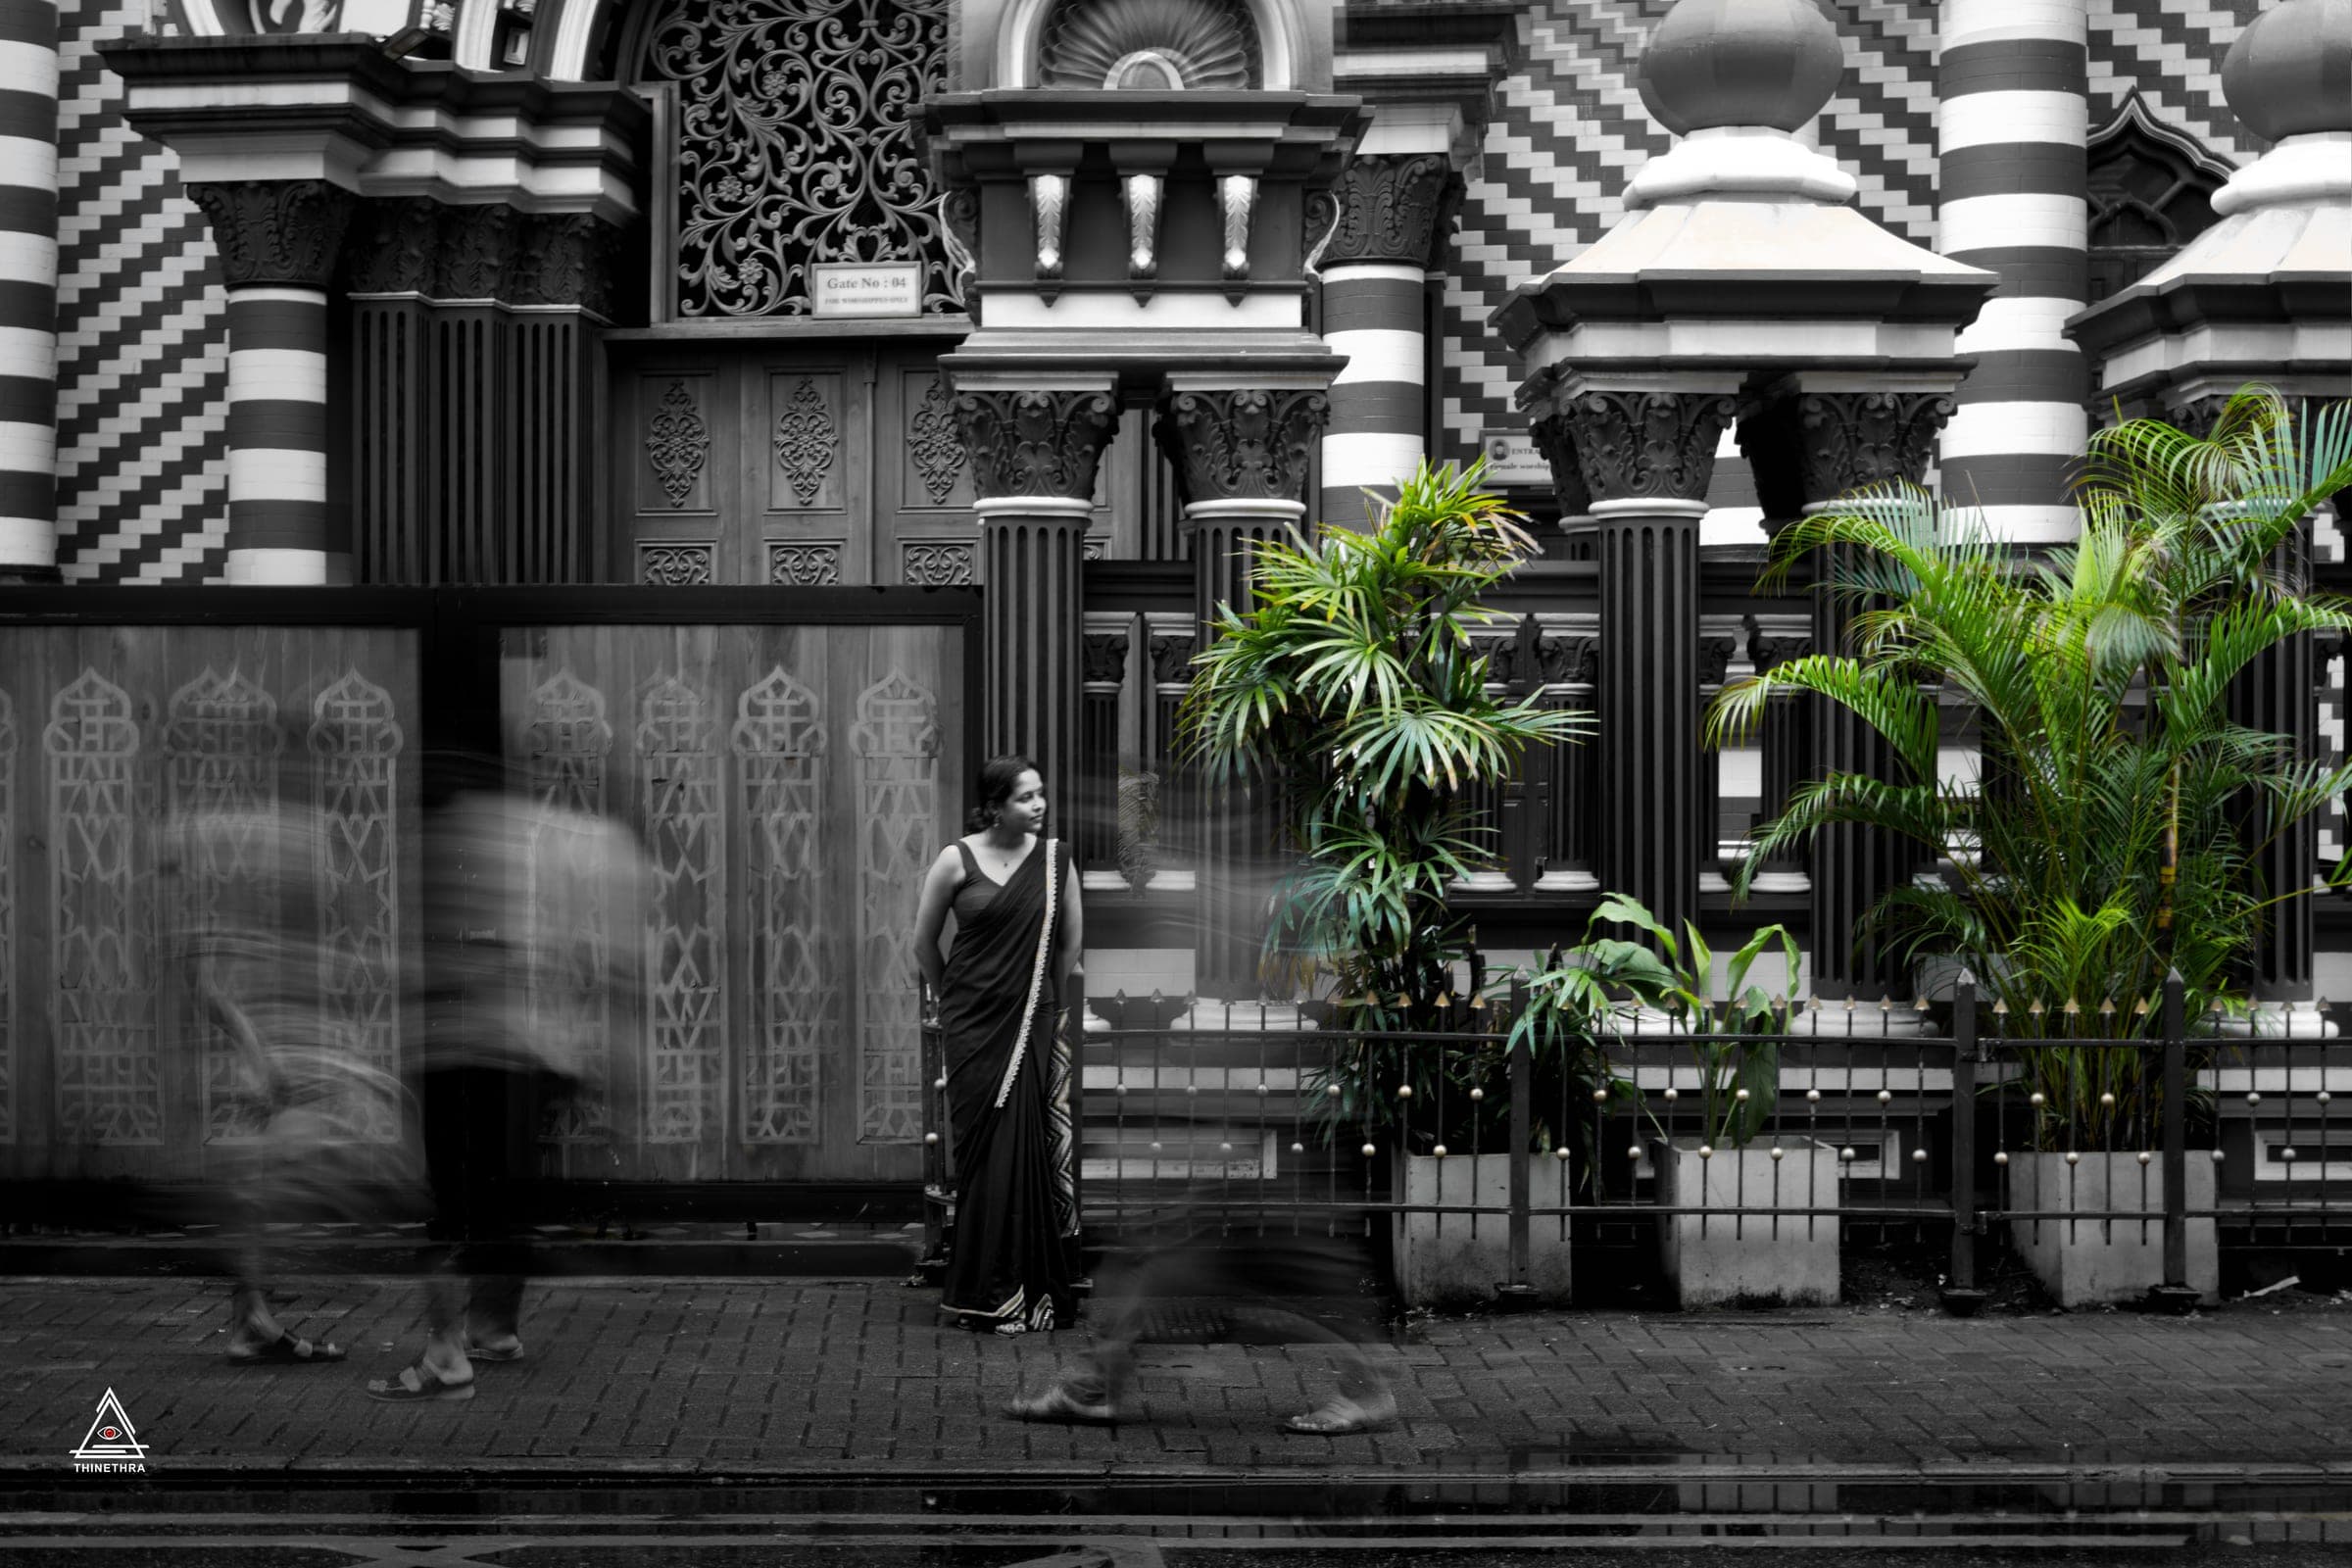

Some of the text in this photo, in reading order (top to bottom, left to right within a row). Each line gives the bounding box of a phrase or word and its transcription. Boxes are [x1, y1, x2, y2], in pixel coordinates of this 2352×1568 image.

[827, 277, 858, 289] Gate
[861, 277, 880, 288] No
[892, 276, 906, 288] 04
